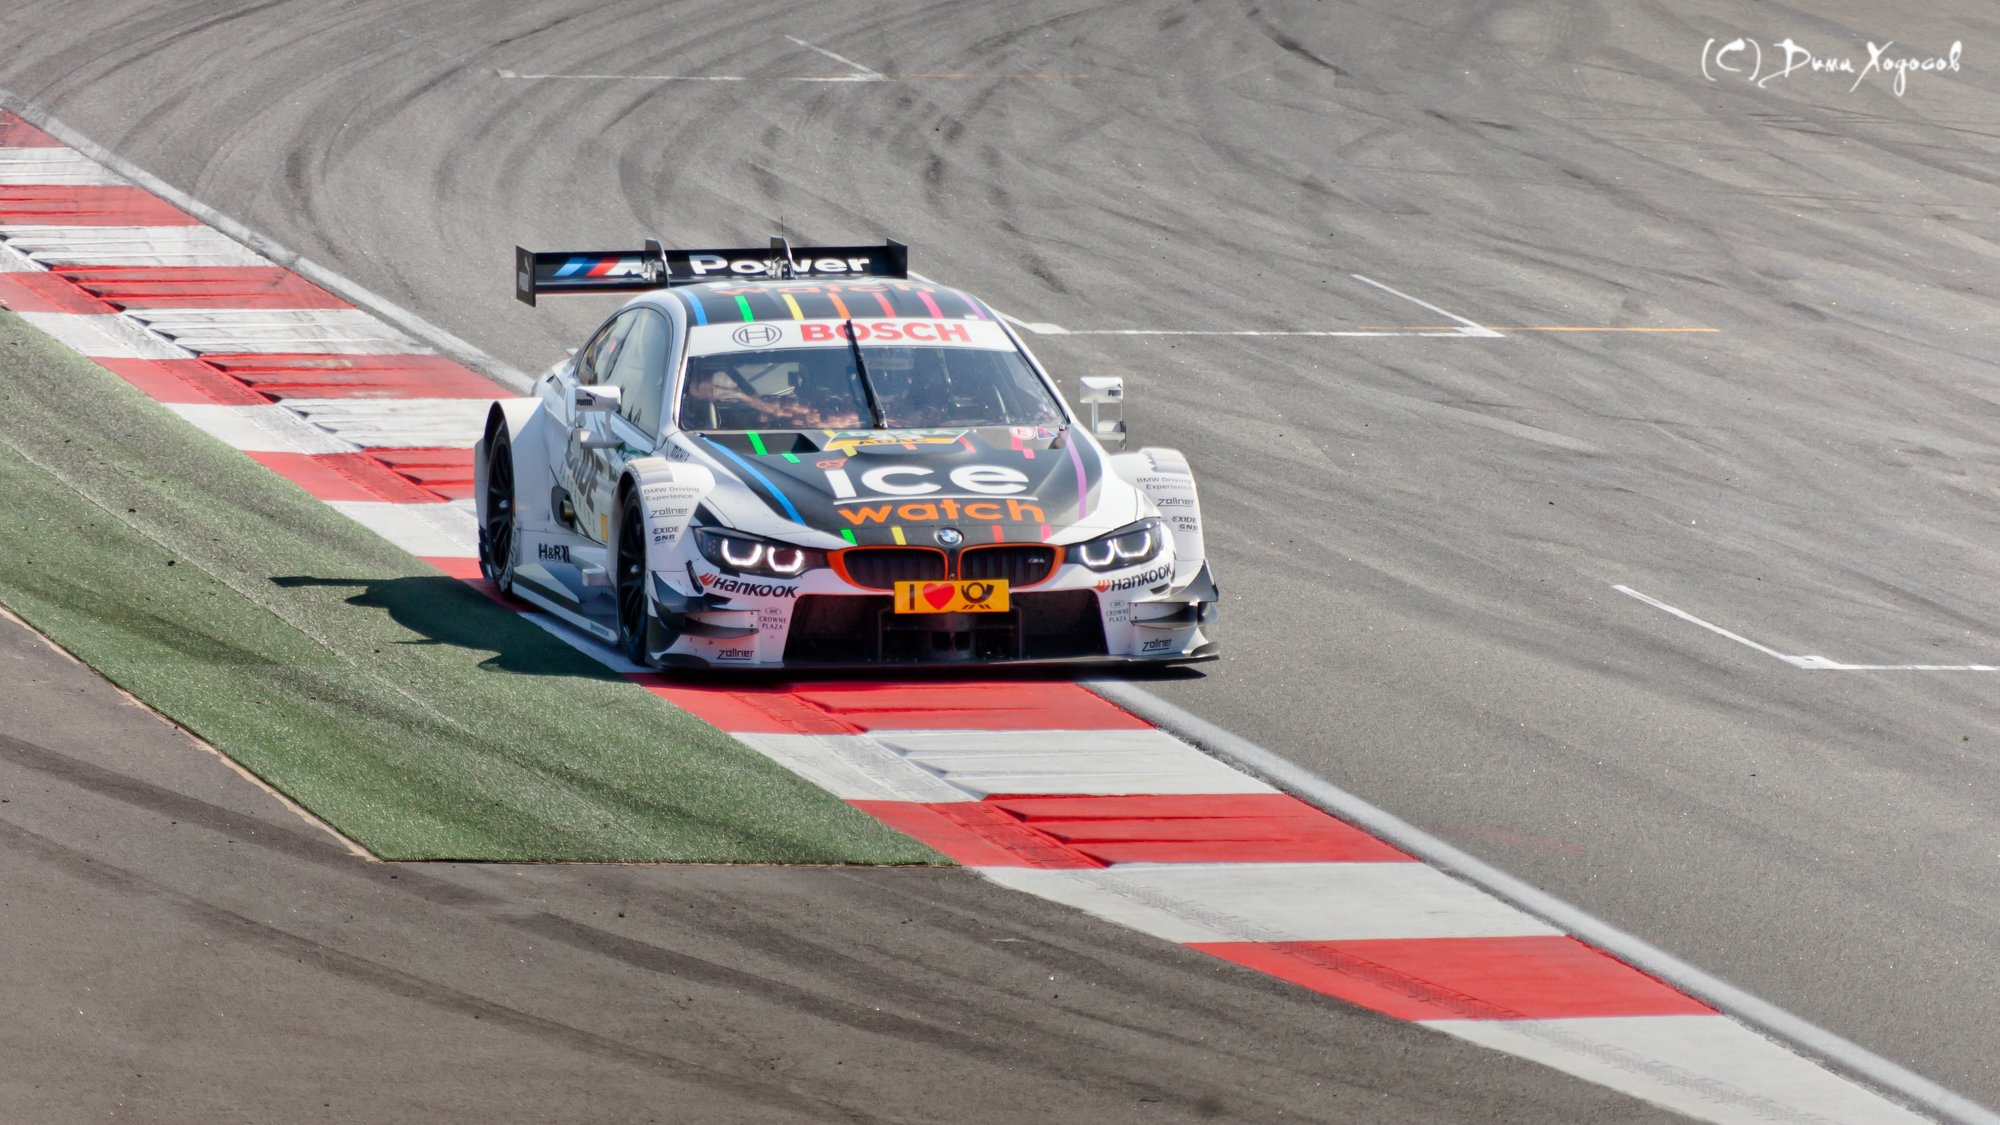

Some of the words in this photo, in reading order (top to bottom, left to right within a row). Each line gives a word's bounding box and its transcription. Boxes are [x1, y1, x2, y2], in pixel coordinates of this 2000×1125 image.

[800, 322, 972, 343] BOSCH
[838, 498, 1046, 526] watch
[653, 526, 679, 535] EXIDE
[759, 616, 786, 624] CROWNE
